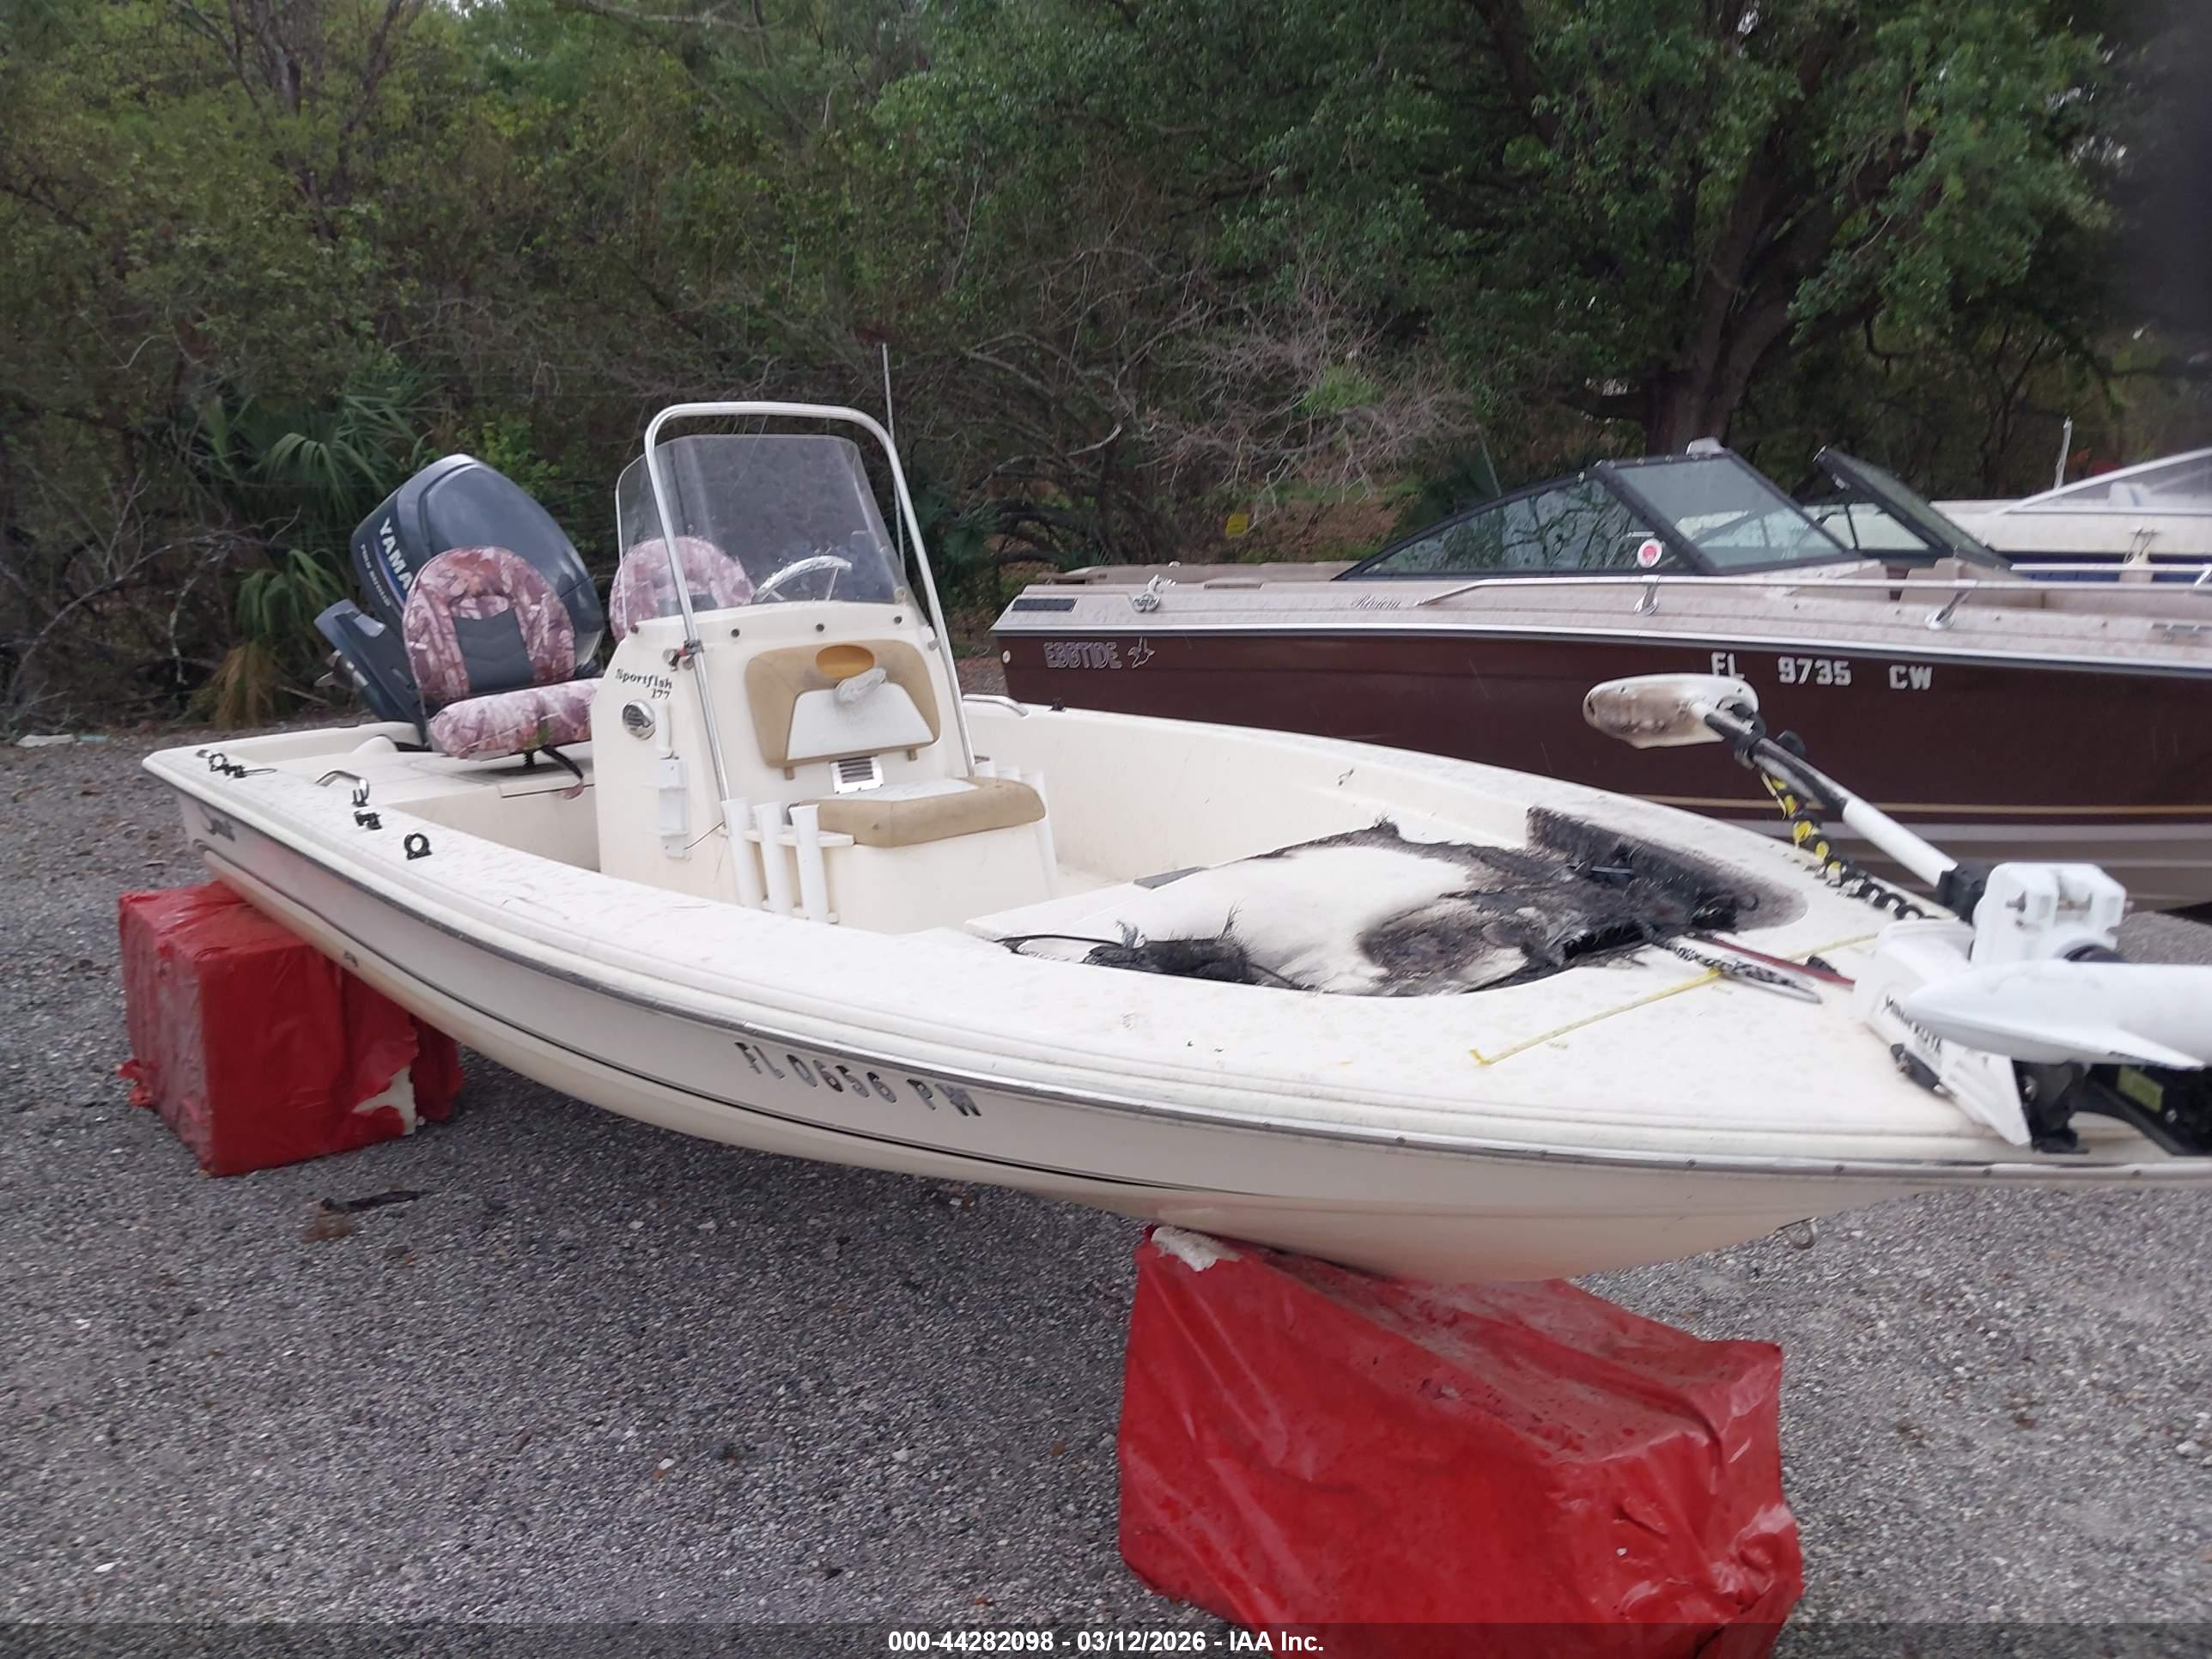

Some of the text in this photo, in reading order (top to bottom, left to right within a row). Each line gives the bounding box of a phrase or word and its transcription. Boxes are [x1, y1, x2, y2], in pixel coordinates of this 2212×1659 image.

[1043, 641, 1122, 669] EBBTIDE
[1711, 652, 1933, 690] FL 9735 CW
[651, 689, 671, 700] 177
